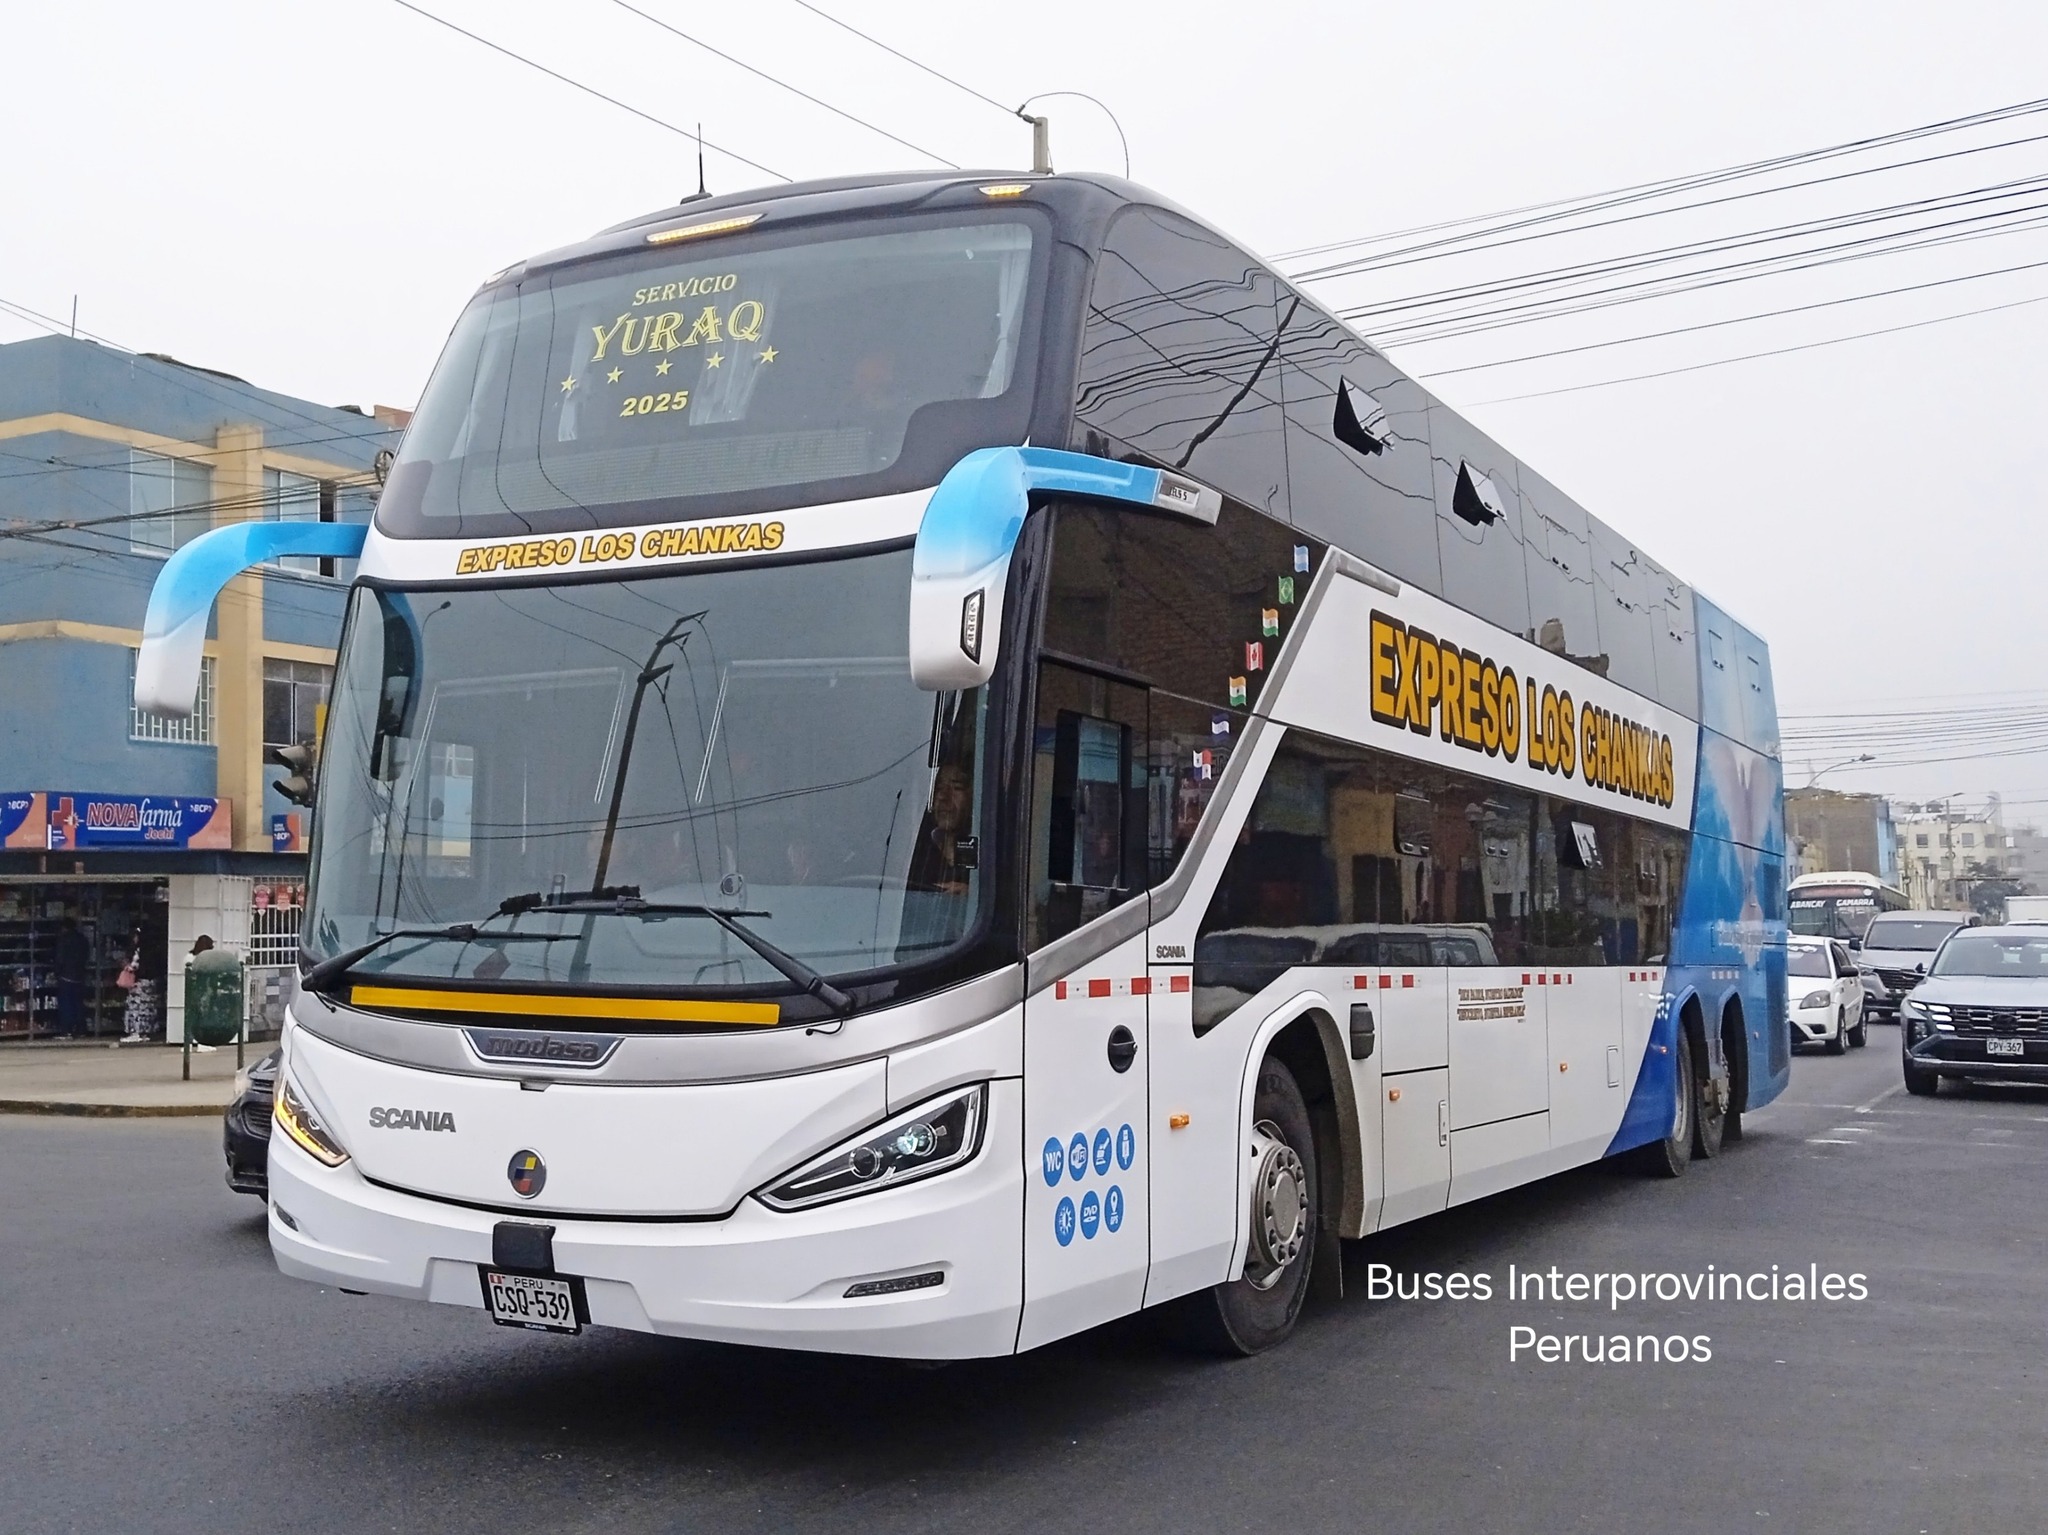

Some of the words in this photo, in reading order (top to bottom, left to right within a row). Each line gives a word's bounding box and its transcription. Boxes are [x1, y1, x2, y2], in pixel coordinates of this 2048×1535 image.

[632, 273, 738, 307] SERVICIO
[590, 300, 766, 363] YURAQ
[619, 390, 689, 418] 2025
[456, 537, 576, 575] EXPRESO
[579, 532, 636, 564] LOS
[640, 521, 785, 558] CHANKAS
[1369, 608, 1521, 764] EXPRESO
[1526, 676, 1577, 780] LOS
[1579, 699, 1676, 810] CHANKAS
[194, 804, 209, 813] BCP
[145, 827, 175, 840] Jochi
[1790, 900, 1826, 909] ABANCAY
[1835, 898, 1875, 907] GAMARRA
[1156, 945, 1186, 959] SCANIA
[488, 1034, 599, 1060] modasa
[1988, 1041, 2022, 1053] CPY-367
[368, 1106, 457, 1133] SCANIA
[1045, 1150, 1062, 1172] WC
[1083, 1205, 1098, 1216] DVD
[1109, 1215, 1119, 1226] GPS
[514, 1277, 544, 1290] PERU
[493, 1285, 570, 1321] CSQ-539
